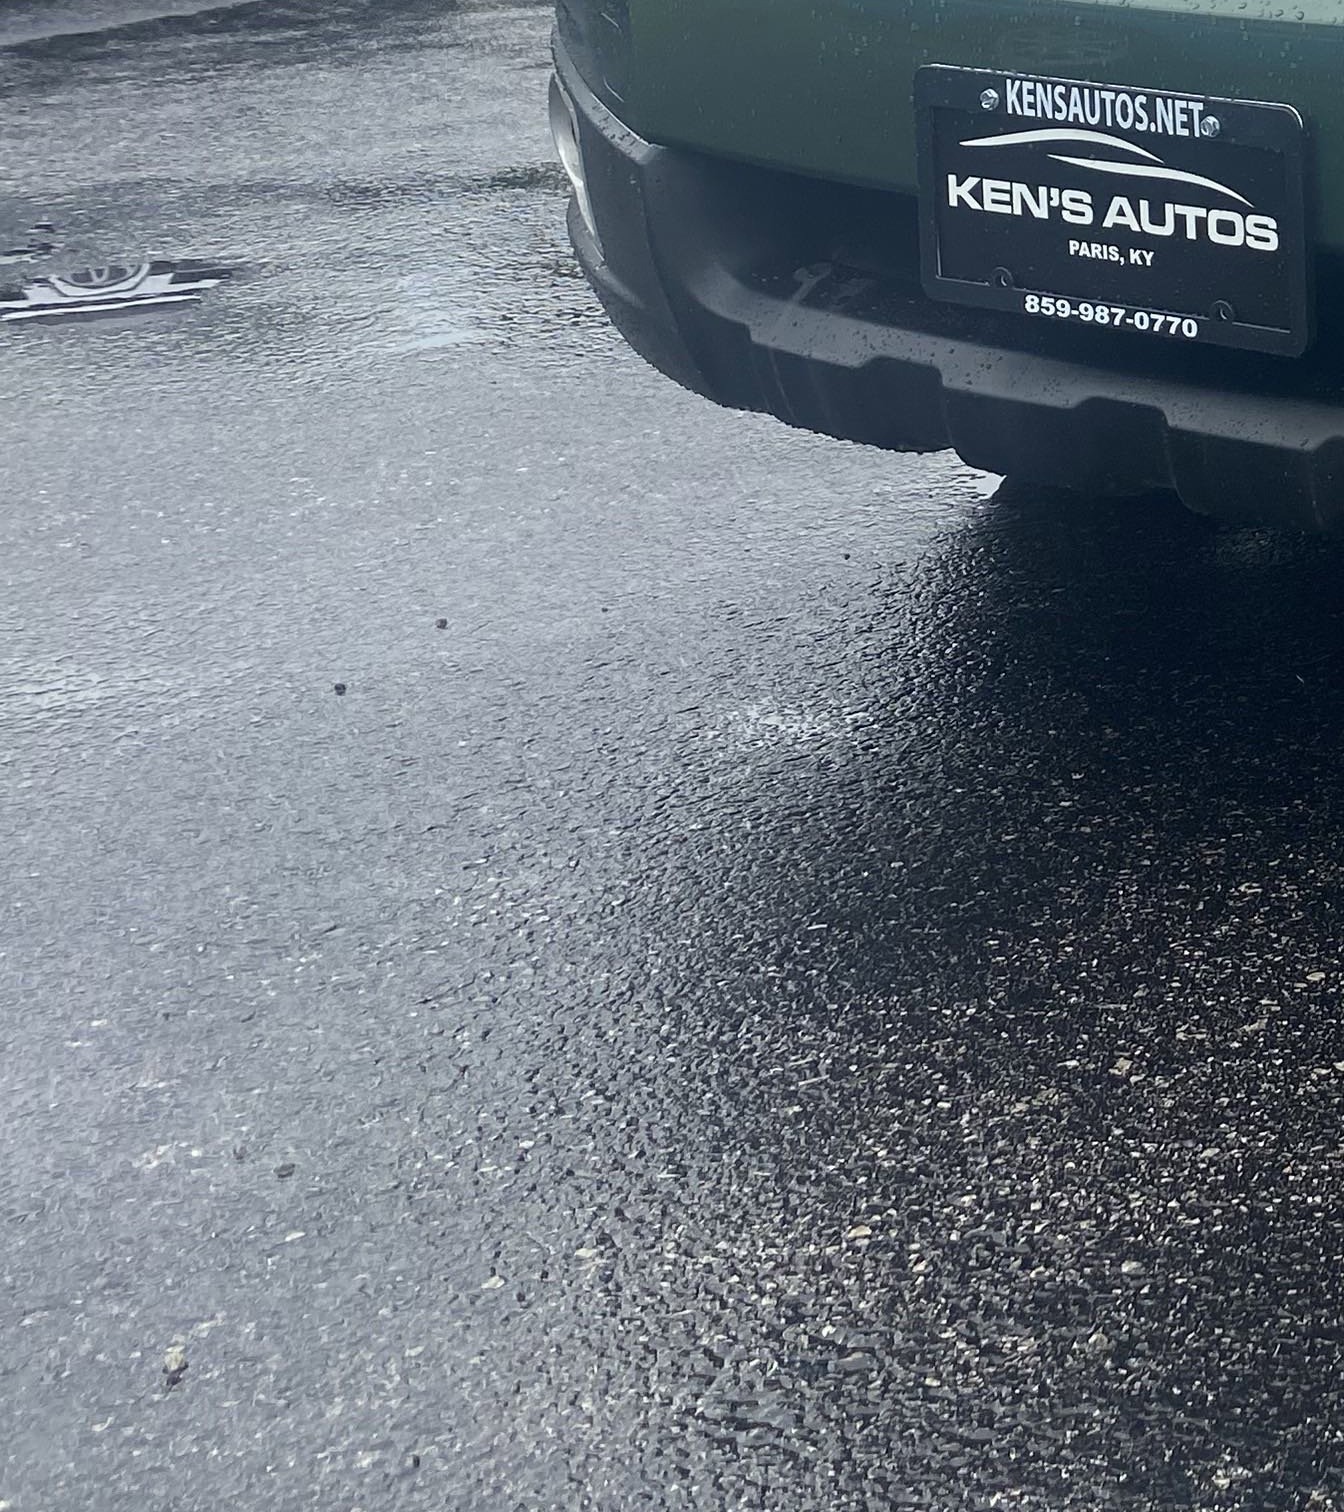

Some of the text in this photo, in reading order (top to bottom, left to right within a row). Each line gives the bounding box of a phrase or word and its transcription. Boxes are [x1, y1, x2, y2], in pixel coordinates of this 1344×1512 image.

[1005, 78, 1204, 138] KENSAUTOS.NET
[946, 173, 1279, 252] KEN'S AUTOS
[1068, 239, 1154, 267] PARIS, KY
[1023, 293, 1199, 338] 859-987-0770
